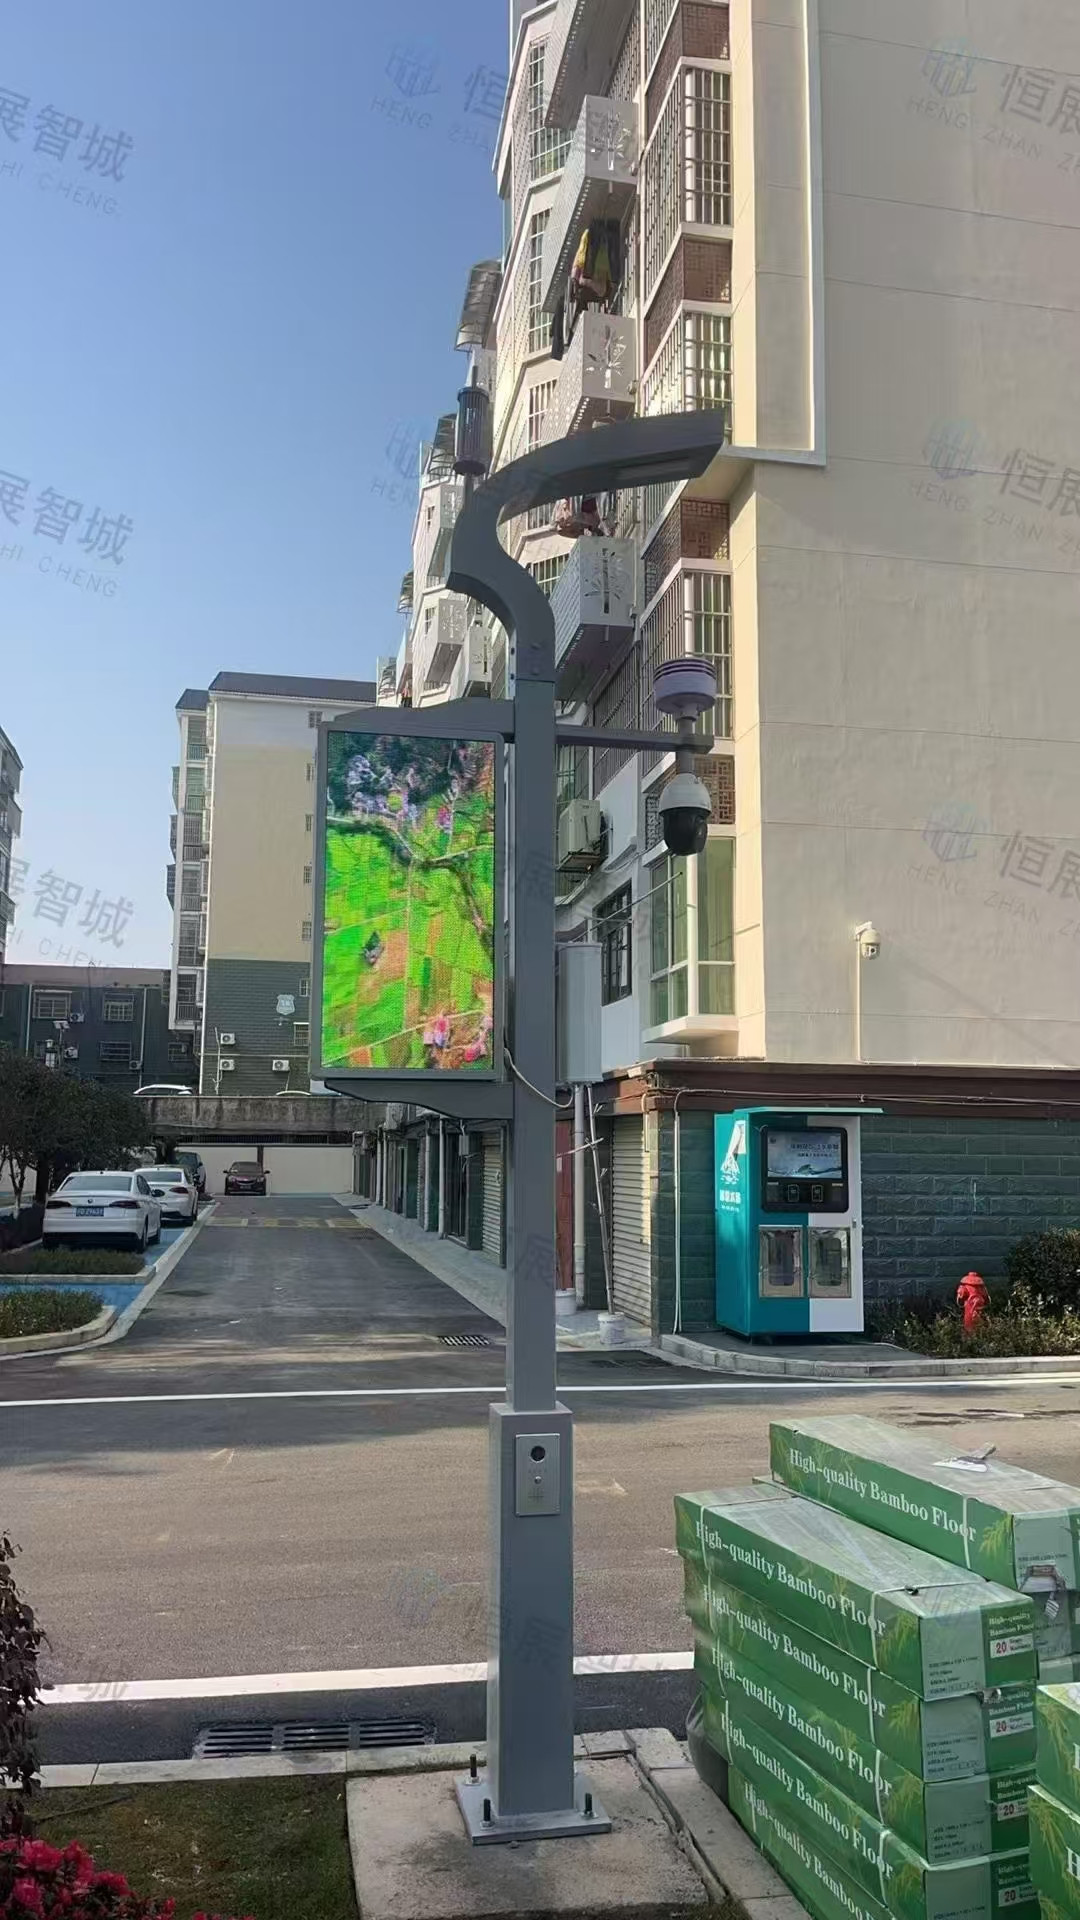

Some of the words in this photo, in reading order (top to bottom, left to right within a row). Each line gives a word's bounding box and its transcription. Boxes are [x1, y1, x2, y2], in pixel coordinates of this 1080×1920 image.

[789, 1448, 868, 1498] High-quality
[869, 1481, 929, 1522] Bamboo
[931, 1505, 977, 1543] Floor
[695, 1520, 775, 1579] High-quality
[776, 1562, 837, 1609] Bamboo
[703, 1585, 780, 1650] High-quality
[783, 1633, 840, 1687] Bamboo
[995, 1641, 1007, 1655] 20
[712, 1648, 786, 1721] High-quality
[787, 1704, 844, 1762] Bamboo
[995, 1720, 1007, 1733] 20
[721, 1711, 794, 1793] High-quality
[796, 1777, 849, 1840] Bamboo
[852, 1828, 894, 1880] Floor
[1003, 1804, 1015, 1816] 20
[744, 1781, 812, 1869] High-quality
[813, 1855, 864, 1920] Bamboo
[1004, 1890, 1016, 1903] 20
